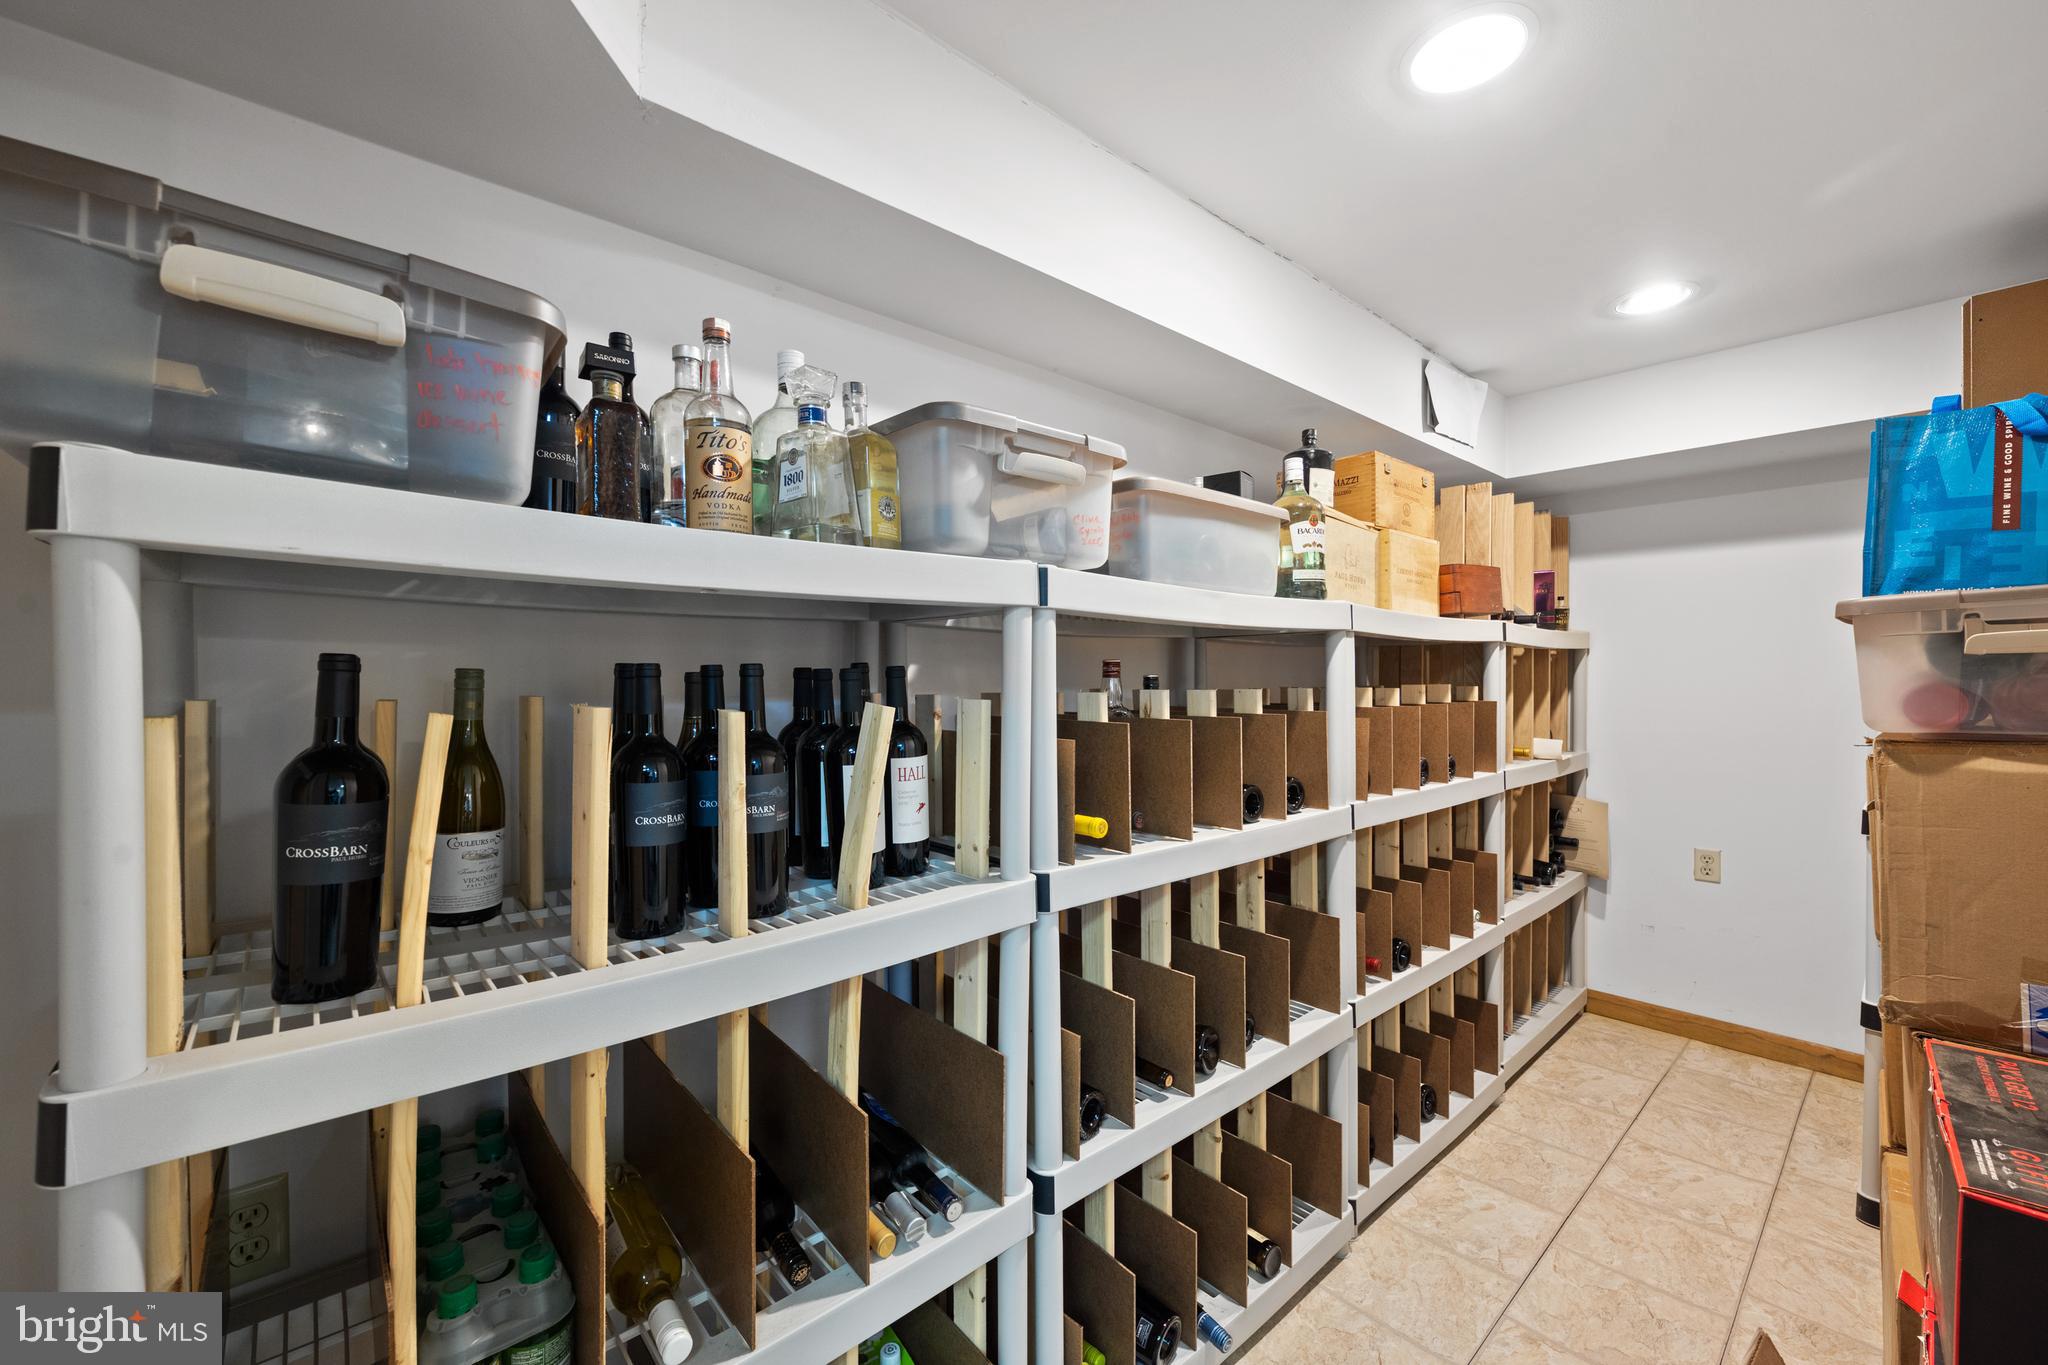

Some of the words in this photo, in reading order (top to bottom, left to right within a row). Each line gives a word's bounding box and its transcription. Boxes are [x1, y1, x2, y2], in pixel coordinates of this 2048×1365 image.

[696, 429, 748, 452] Tito's
[536, 449, 577, 466] CROSSBA
[2004, 442, 2013, 465] GOOD
[783, 469, 804, 487] 1800
[692, 484, 752, 504] Handmade
[2003, 477, 2012, 500] WINE
[706, 502, 741, 511] VODKA
[2002, 503, 2011, 524] FINE
[897, 765, 926, 782] HALL
[446, 836, 489, 850] COULEURS
[462, 872, 499, 884] VIOGNIE
[2004, 1080, 2033, 1100] GET
[2012, 1097, 2040, 1112] 12
